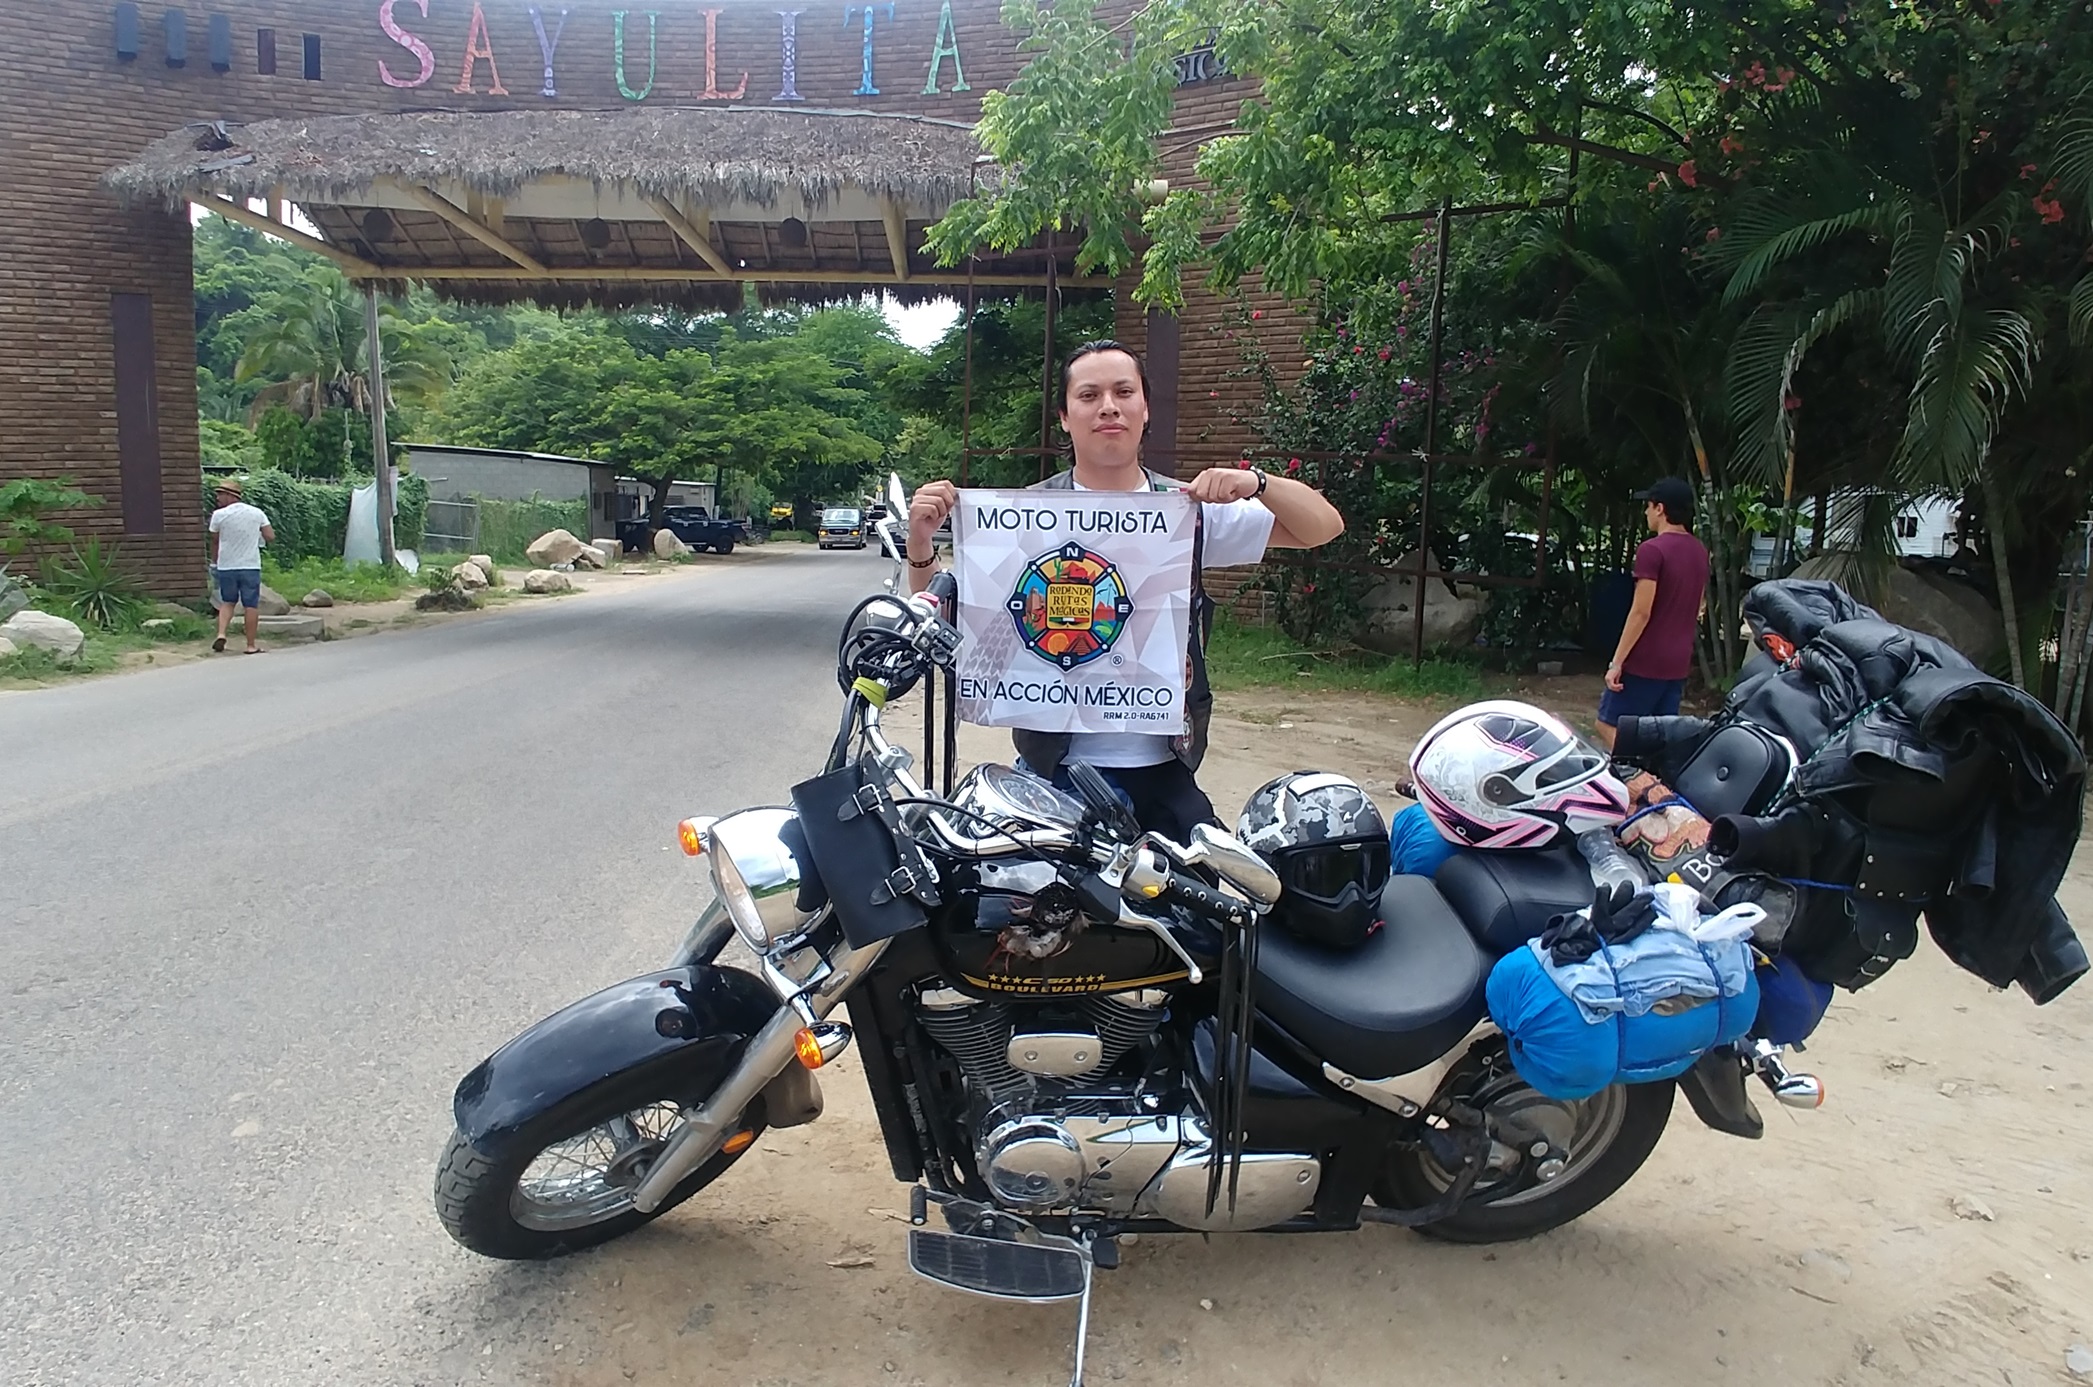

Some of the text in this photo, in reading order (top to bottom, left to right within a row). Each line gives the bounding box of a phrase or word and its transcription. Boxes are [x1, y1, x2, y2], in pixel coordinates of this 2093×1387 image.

[378, 0, 971, 101] SAYULITA
[977, 507, 1168, 534] MOTO TURISTA
[1066, 547, 1079, 557] N
[1118, 604, 1129, 613] E
[1062, 656, 1071, 666] S
[961, 679, 1173, 706] EN ACCIÓN MÉXICO
[1103, 711, 1122, 720] RRM
[990, 983, 1100, 993] BOULEVARD
